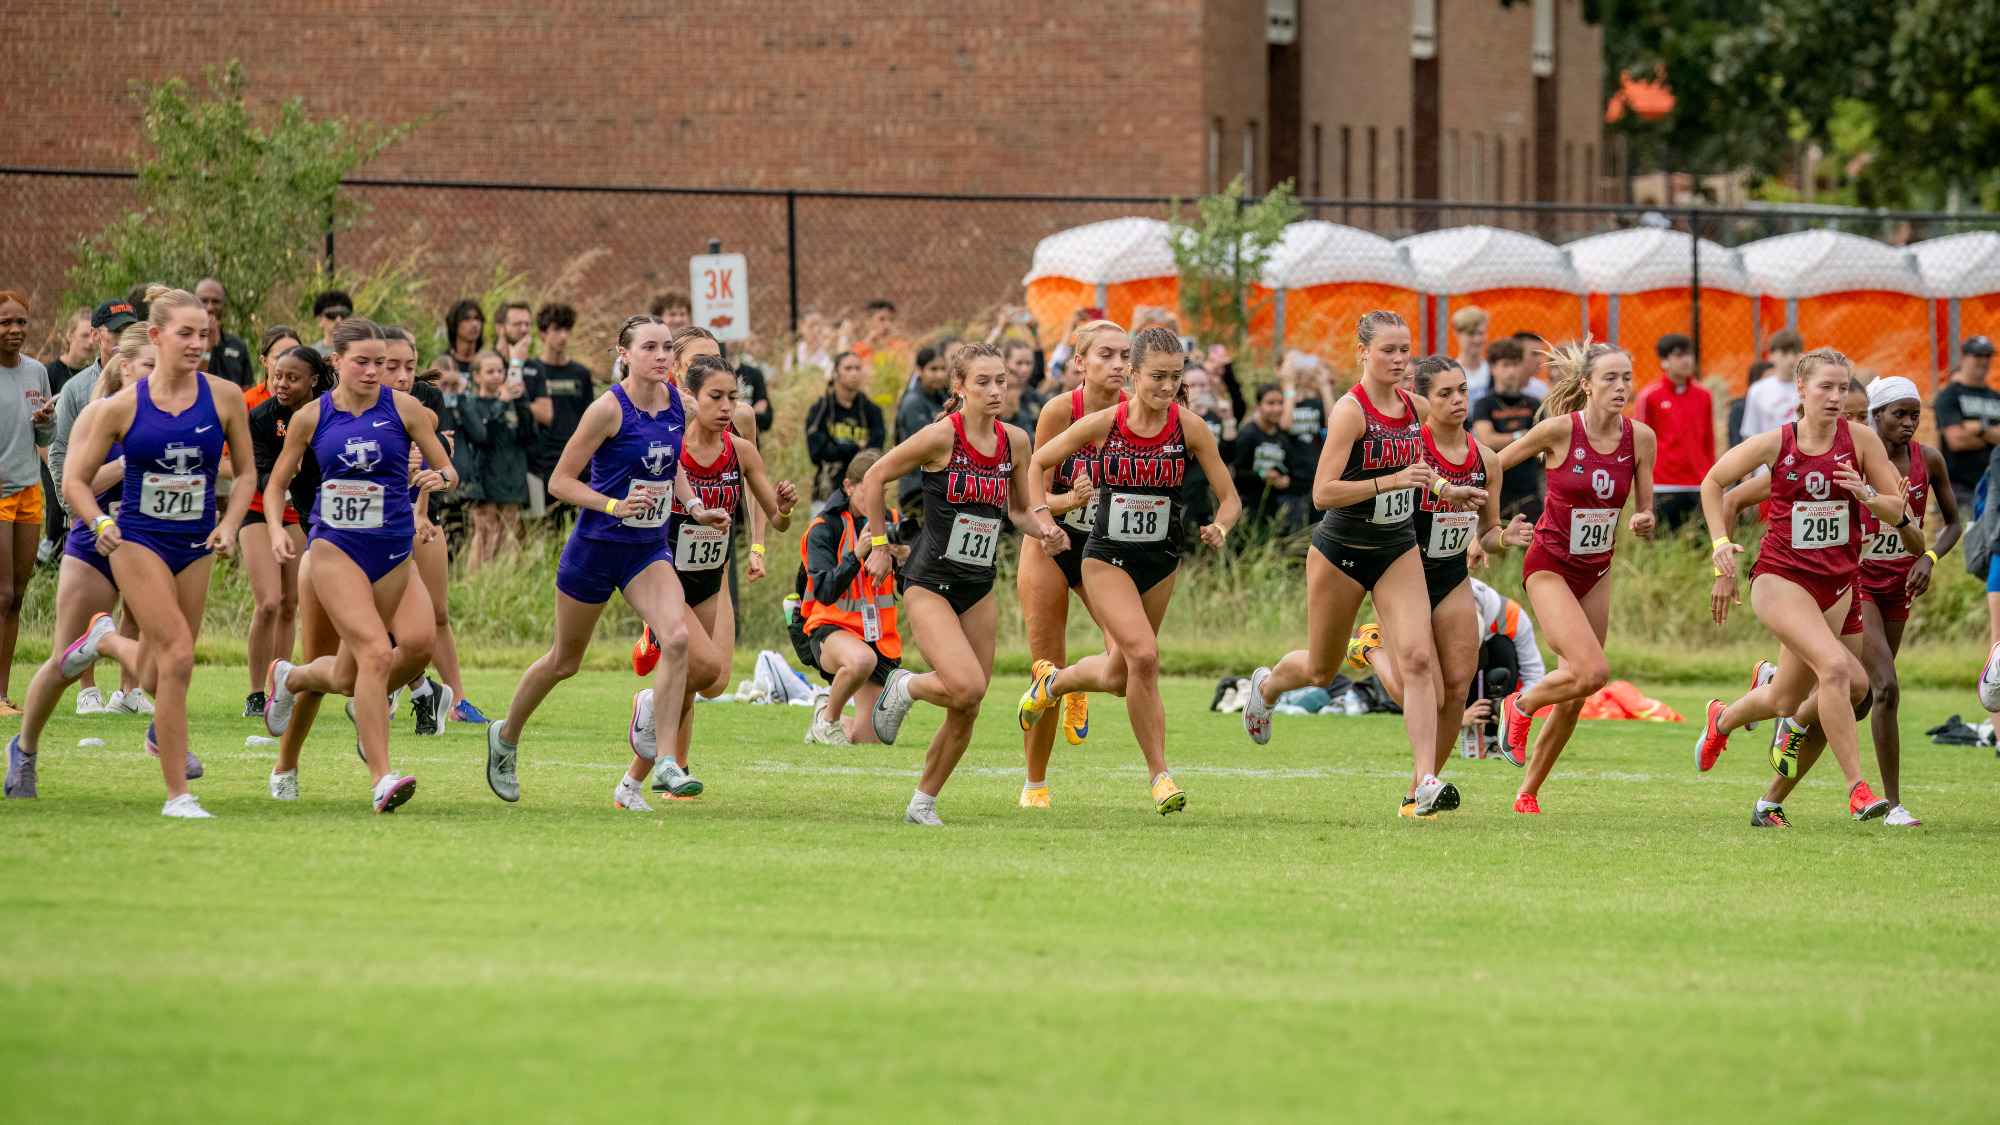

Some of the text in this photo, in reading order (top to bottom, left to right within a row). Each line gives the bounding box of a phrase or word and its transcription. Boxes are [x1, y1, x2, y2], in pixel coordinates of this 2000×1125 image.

[705, 268, 734, 299] 3K
[1363, 437, 1423, 470] LAMA
[1104, 456, 1185, 488] LAMAR
[1592, 469, 1615, 499] OU
[947, 472, 1011, 508] LAMA
[1805, 471, 1831, 500] OU
[153, 490, 192, 513] 370
[332, 497, 371, 521] 367
[1384, 490, 1409, 518] 139
[970, 520, 993, 529] COWBOY
[1077, 504, 1099, 525] 13
[1121, 511, 1157, 535] 138
[1439, 527, 1469, 551] 137
[1580, 524, 1610, 547] 294
[1803, 518, 1840, 542] 295
[688, 542, 723, 564] 135
[958, 532, 991, 558] 131
[1872, 534, 1906, 554] 29
